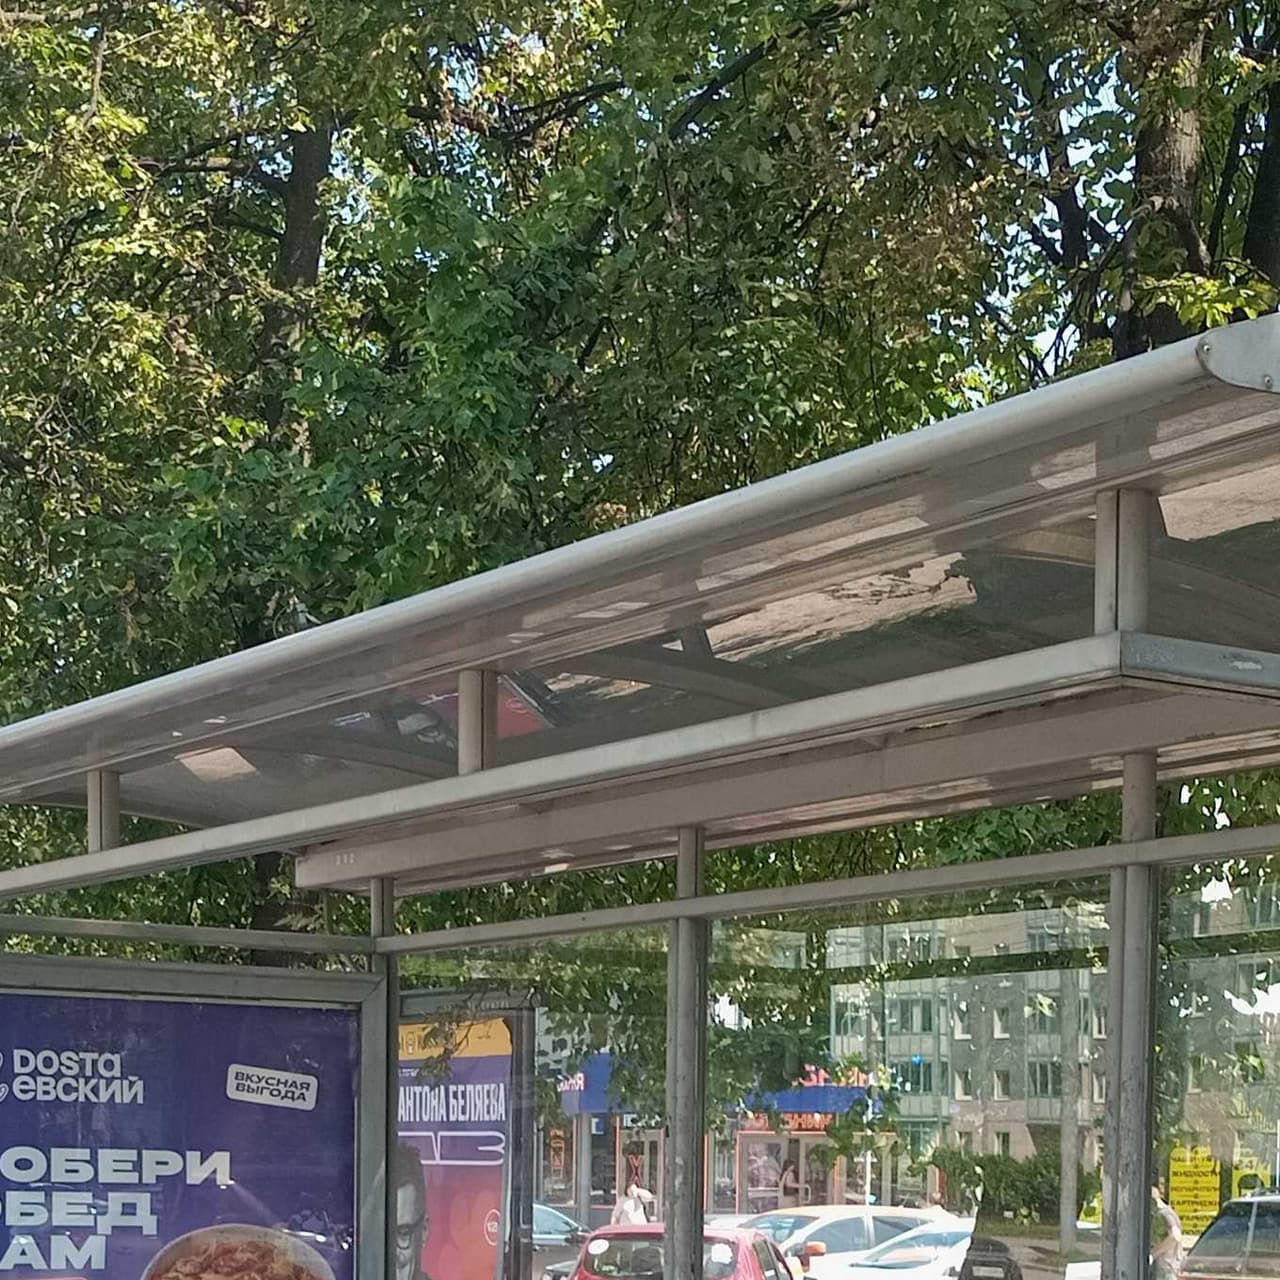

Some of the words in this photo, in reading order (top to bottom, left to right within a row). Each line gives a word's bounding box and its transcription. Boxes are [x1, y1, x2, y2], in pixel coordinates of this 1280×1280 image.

[234, 1071, 311, 1092] ВКУСНАЯ
[235, 1082, 307, 1102] ВЫГОДА
[398, 1084, 447, 1122] АНТОНА
[449, 1083, 506, 1121] БЕЛЯЕВА
